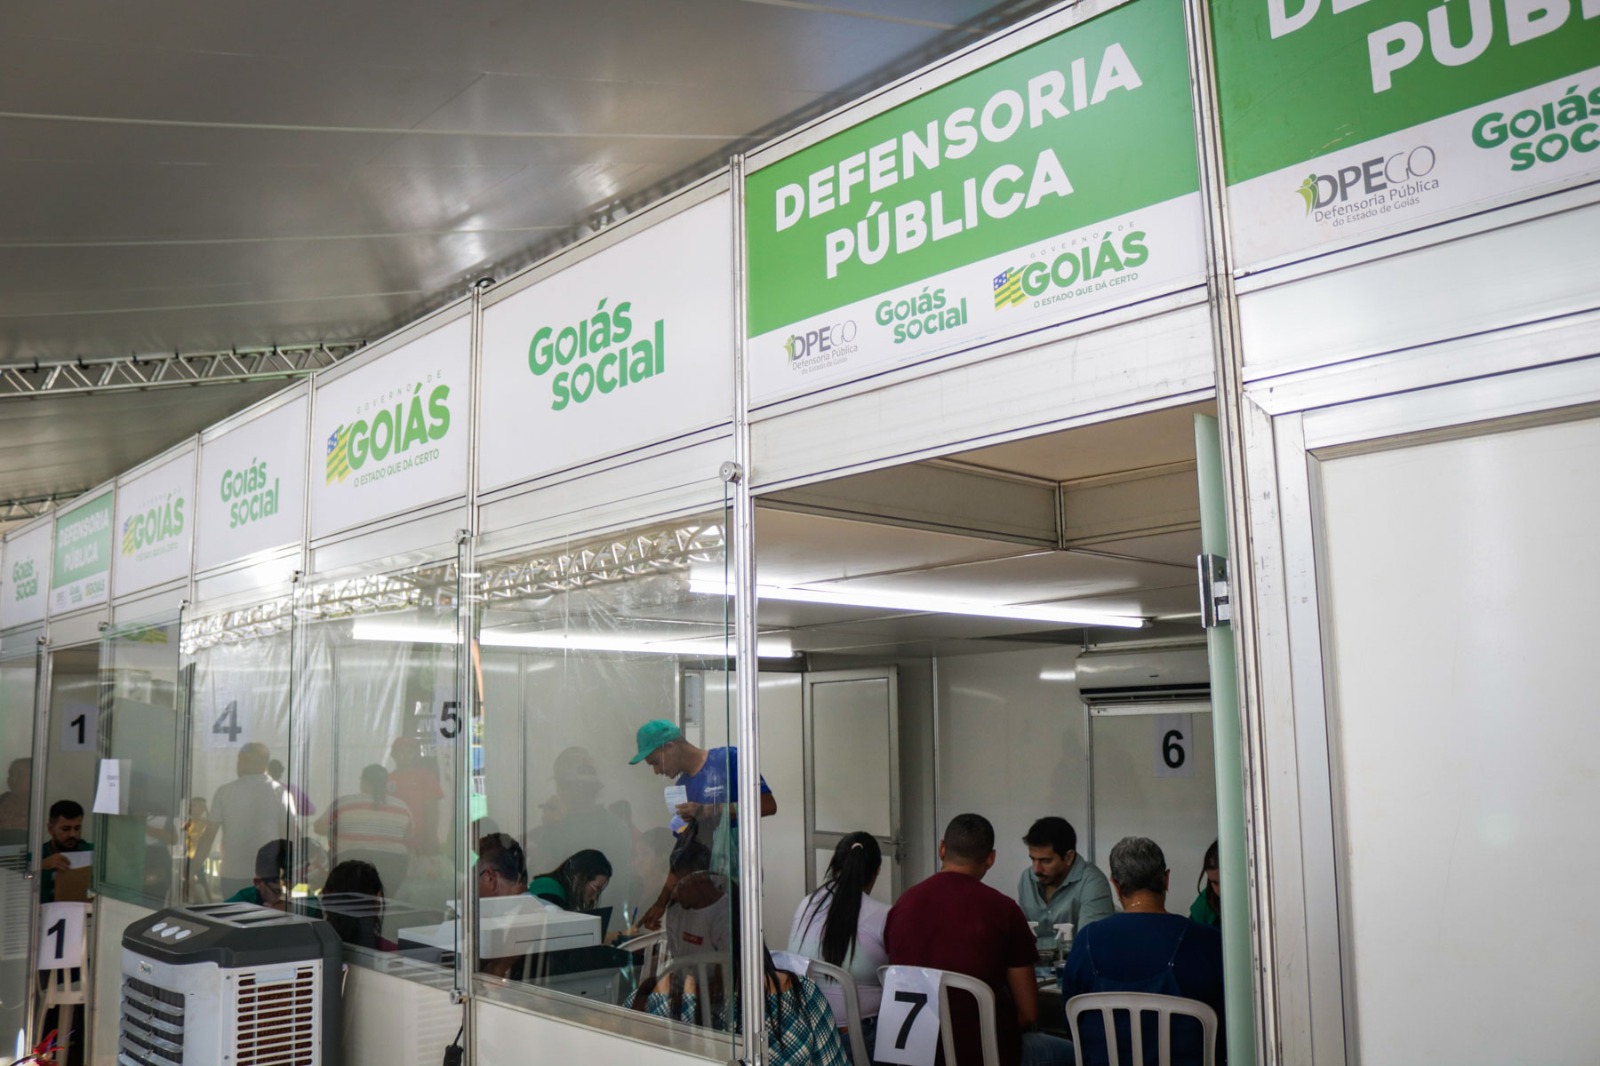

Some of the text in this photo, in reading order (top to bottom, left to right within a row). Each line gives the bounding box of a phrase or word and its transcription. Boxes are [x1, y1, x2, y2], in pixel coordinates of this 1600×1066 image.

[1367, 0, 1600, 94] PÚB
[775, 42, 1143, 233] DEFENSORIA
[825, 147, 1075, 280] PÚBLICA
[1314, 178, 1440, 223] Defensoria Pública
[1332, 196, 1421, 227] do Estado de Goiás
[1030, 221, 1135, 259] GOVERNO DE
[1021, 230, 1149, 297] GOIÁS
[1033, 272, 1139, 309] O ESTADO QUE DÁ CERTO
[792, 352, 830, 371] Defensoria
[347, 382, 451, 471] GOIÁS
[360, 468, 386, 485] ESTADO
[387, 462, 402, 476] QUE
[403, 455, 413, 470] DÁ
[414, 448, 440, 465] CERTO
[133, 493, 185, 550] GOIÁS
[71, 714, 85, 744] 1
[212, 700, 242, 742] 4
[439, 701, 462, 739] 5
[1162, 729, 1185, 769] 6
[47, 918, 67, 959] 1
[894, 990, 928, 1050] 7
